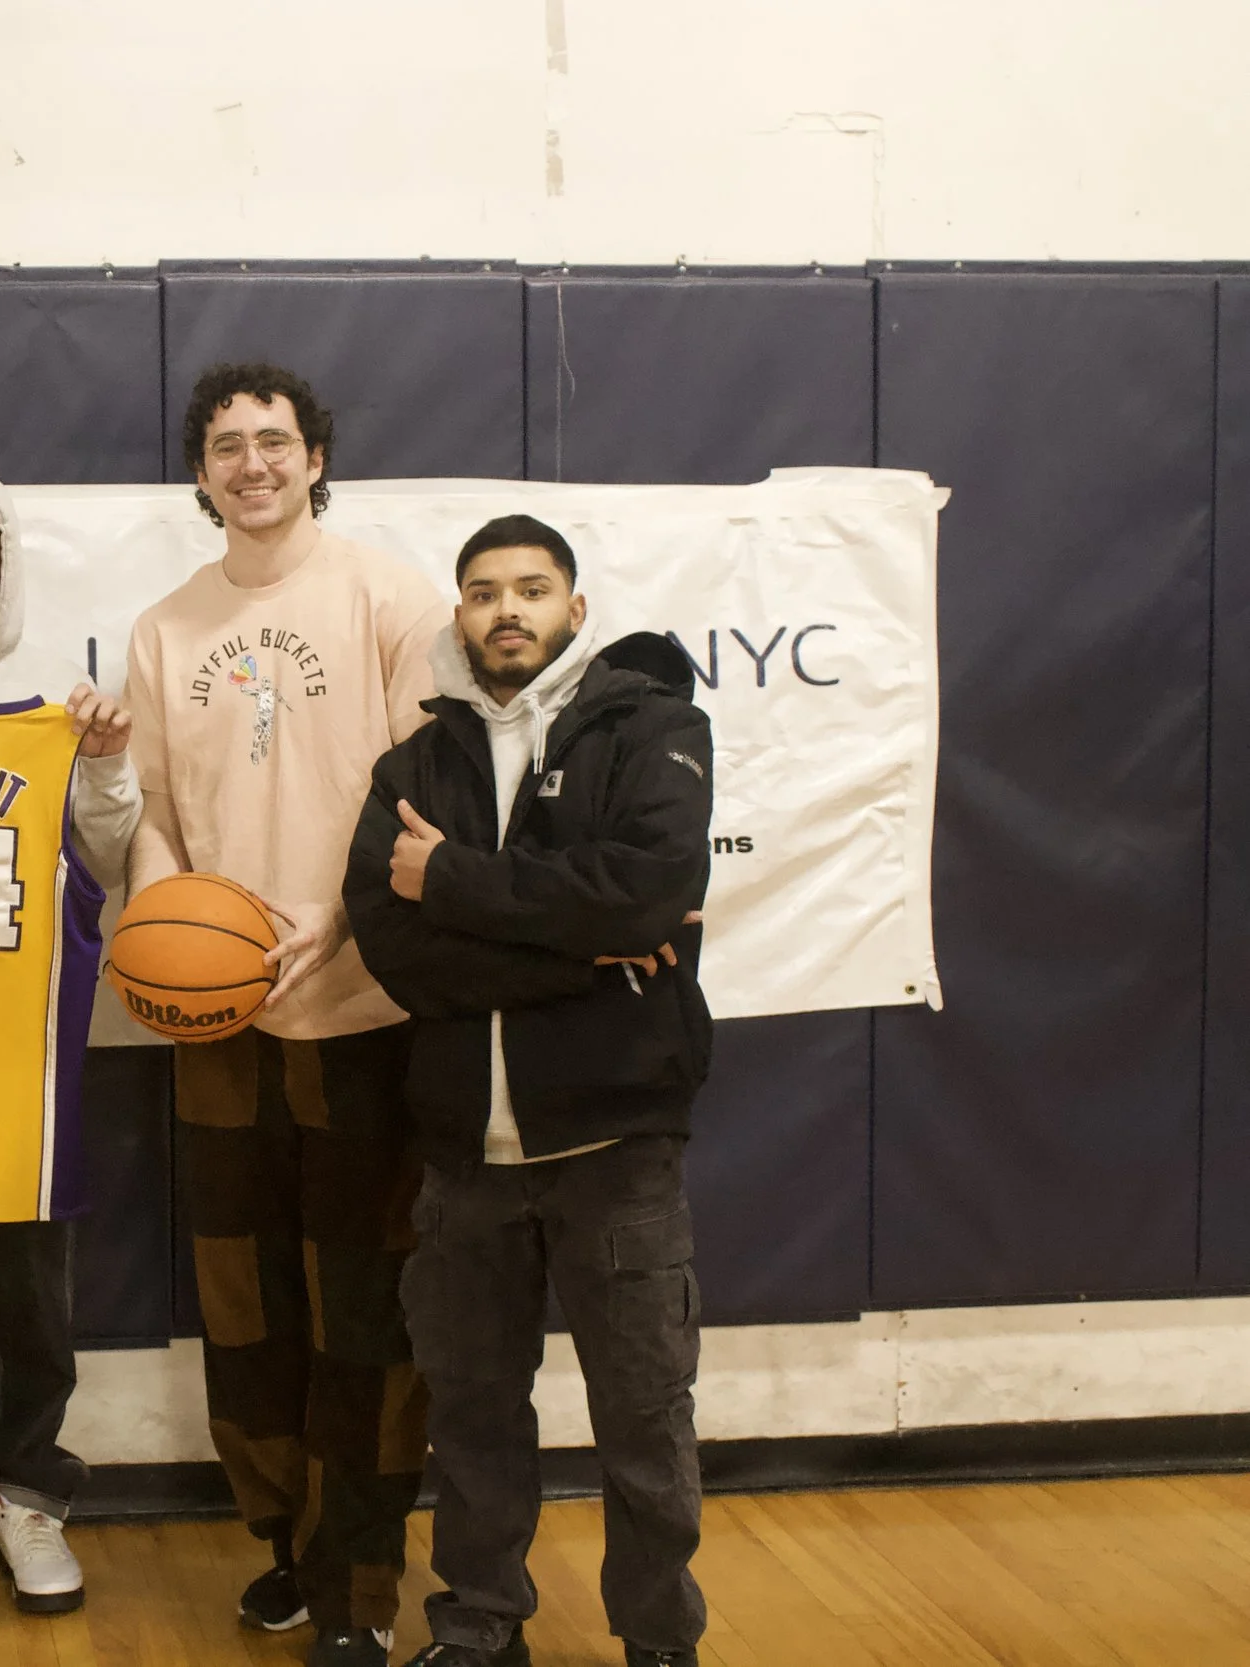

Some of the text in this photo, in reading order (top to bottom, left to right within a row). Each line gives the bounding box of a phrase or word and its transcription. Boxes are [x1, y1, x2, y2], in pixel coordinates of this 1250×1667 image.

[189, 628, 327, 707] JOYFUL BUCKETS
[665, 624, 840, 690] NYC
[124, 987, 237, 1028] Wilson
